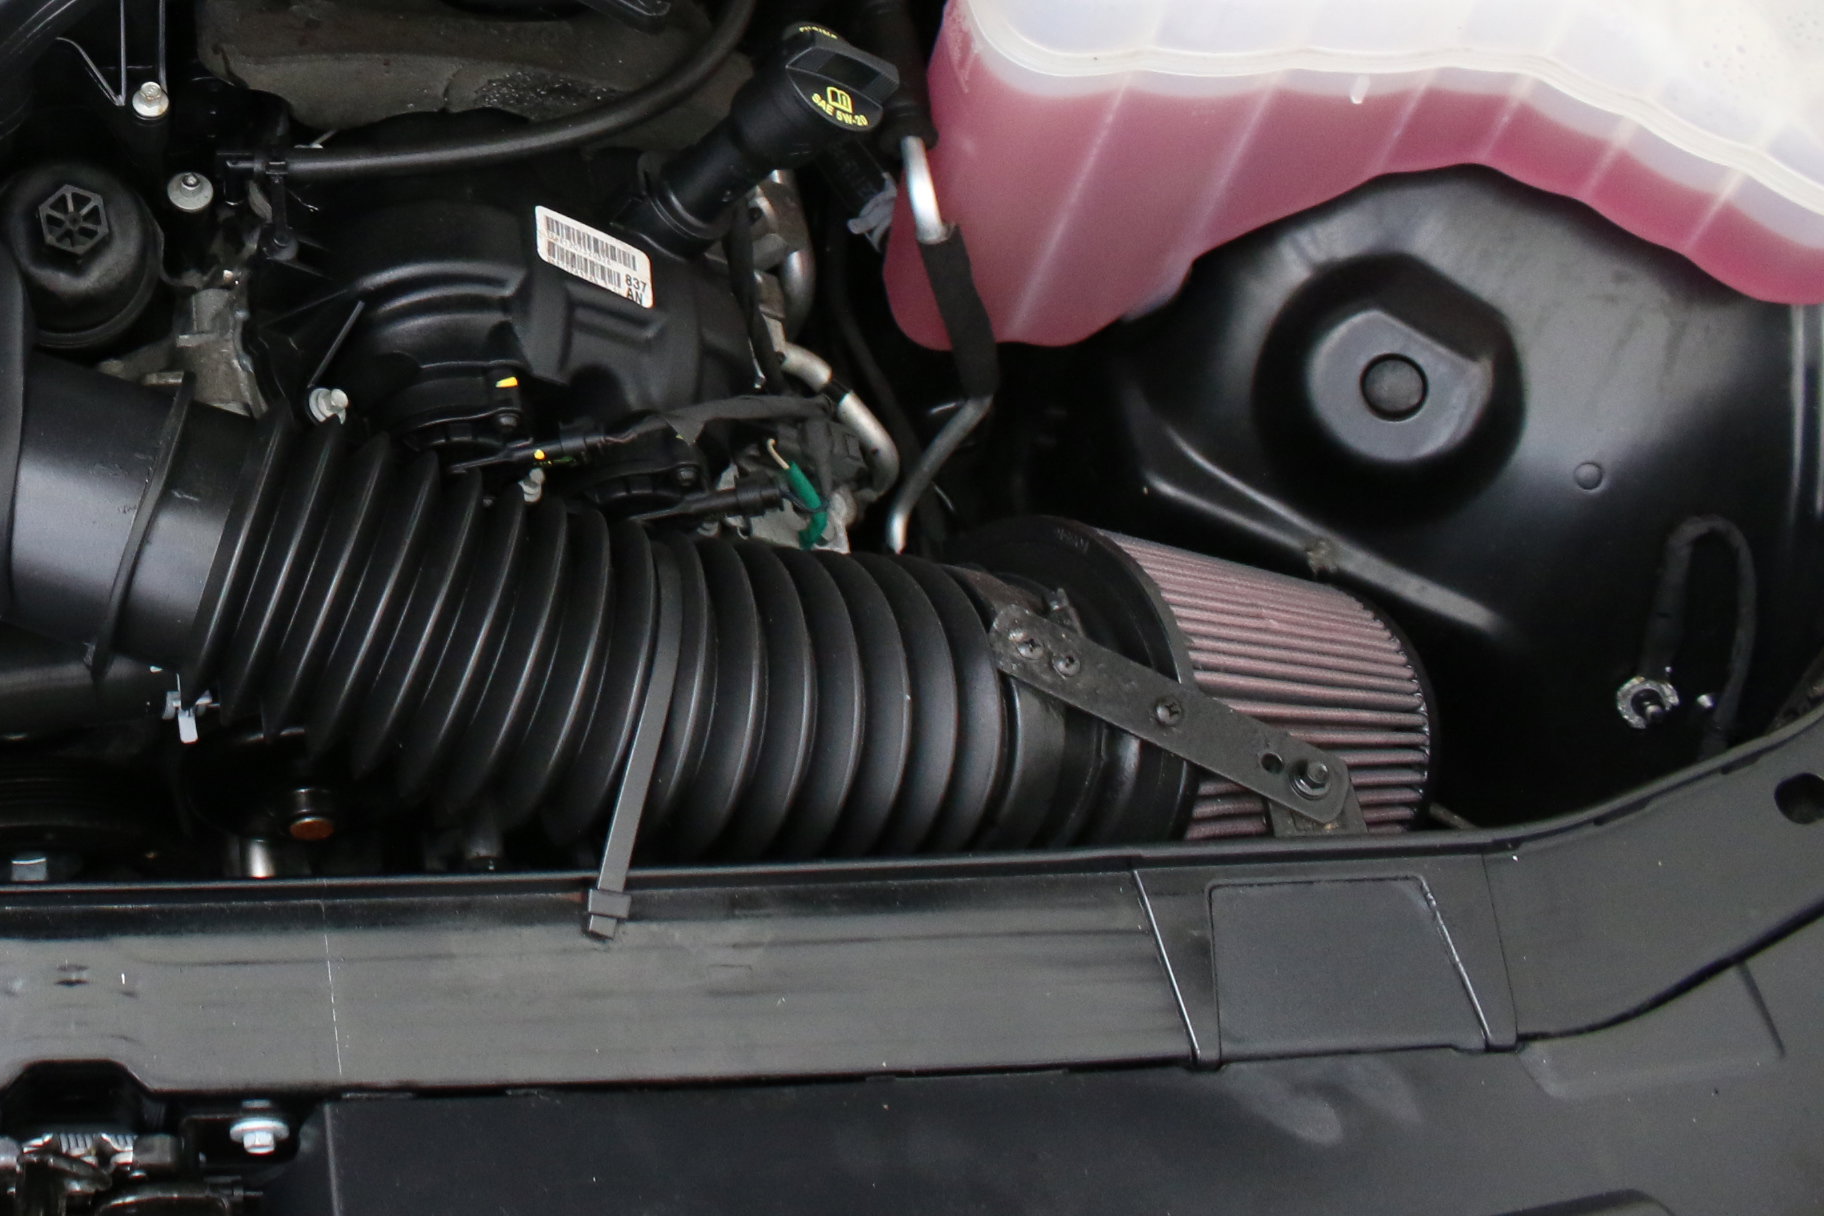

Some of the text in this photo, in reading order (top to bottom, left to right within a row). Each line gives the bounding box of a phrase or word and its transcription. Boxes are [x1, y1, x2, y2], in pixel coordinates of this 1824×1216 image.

[811, 92, 869, 127] SAE 5W-20
[625, 274, 647, 292] 837
[626, 288, 643, 305] AN
